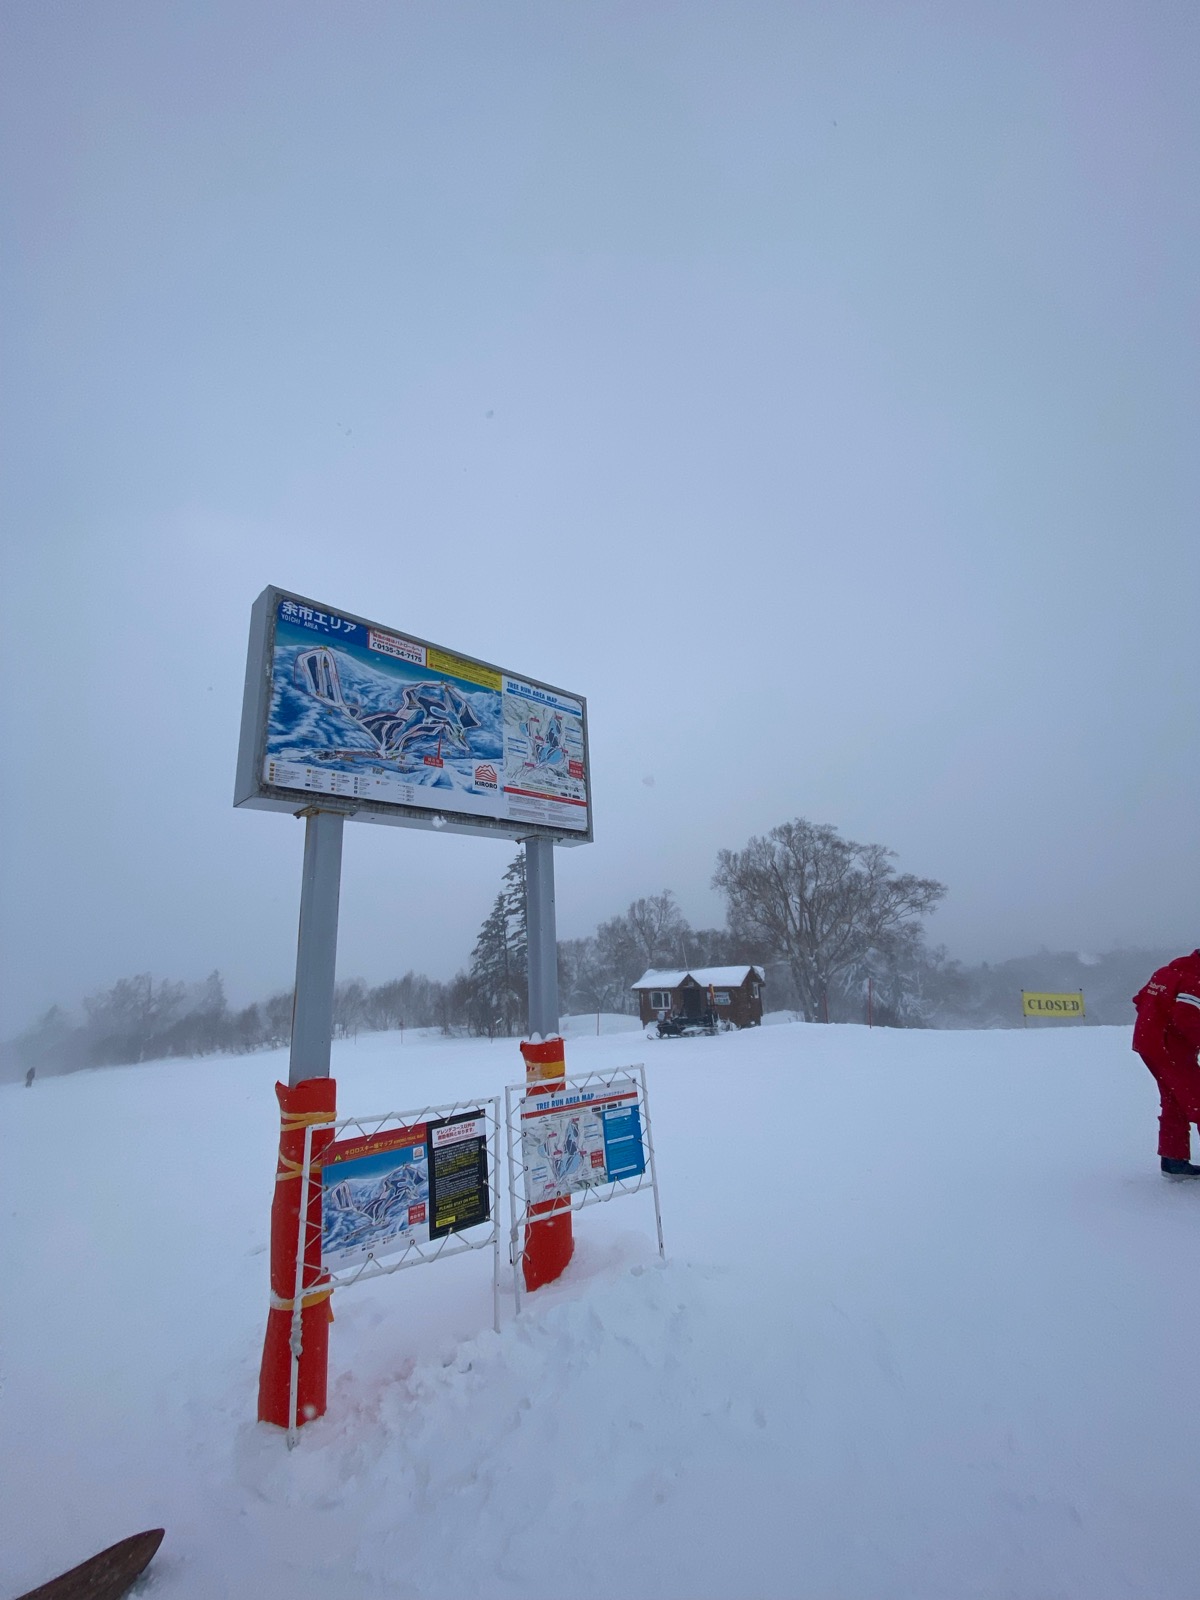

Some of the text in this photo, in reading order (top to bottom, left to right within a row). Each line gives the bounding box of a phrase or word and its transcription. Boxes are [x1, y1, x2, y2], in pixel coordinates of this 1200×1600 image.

[281, 601, 357, 633] 余市エリア
[281, 613, 319, 631] YOICHI AREA
[377, 643, 422, 663] 0135-34-7175
[507, 681, 519, 690] TREE
[520, 685, 532, 695] RUN
[532, 689, 545, 700] AREA
[546, 695, 558, 703] MAP
[474, 780, 498, 790] KIRORO
[1027, 999, 1080, 1011] CLOSED
[536, 1092, 595, 1111] TREE RUN AREA MAP
